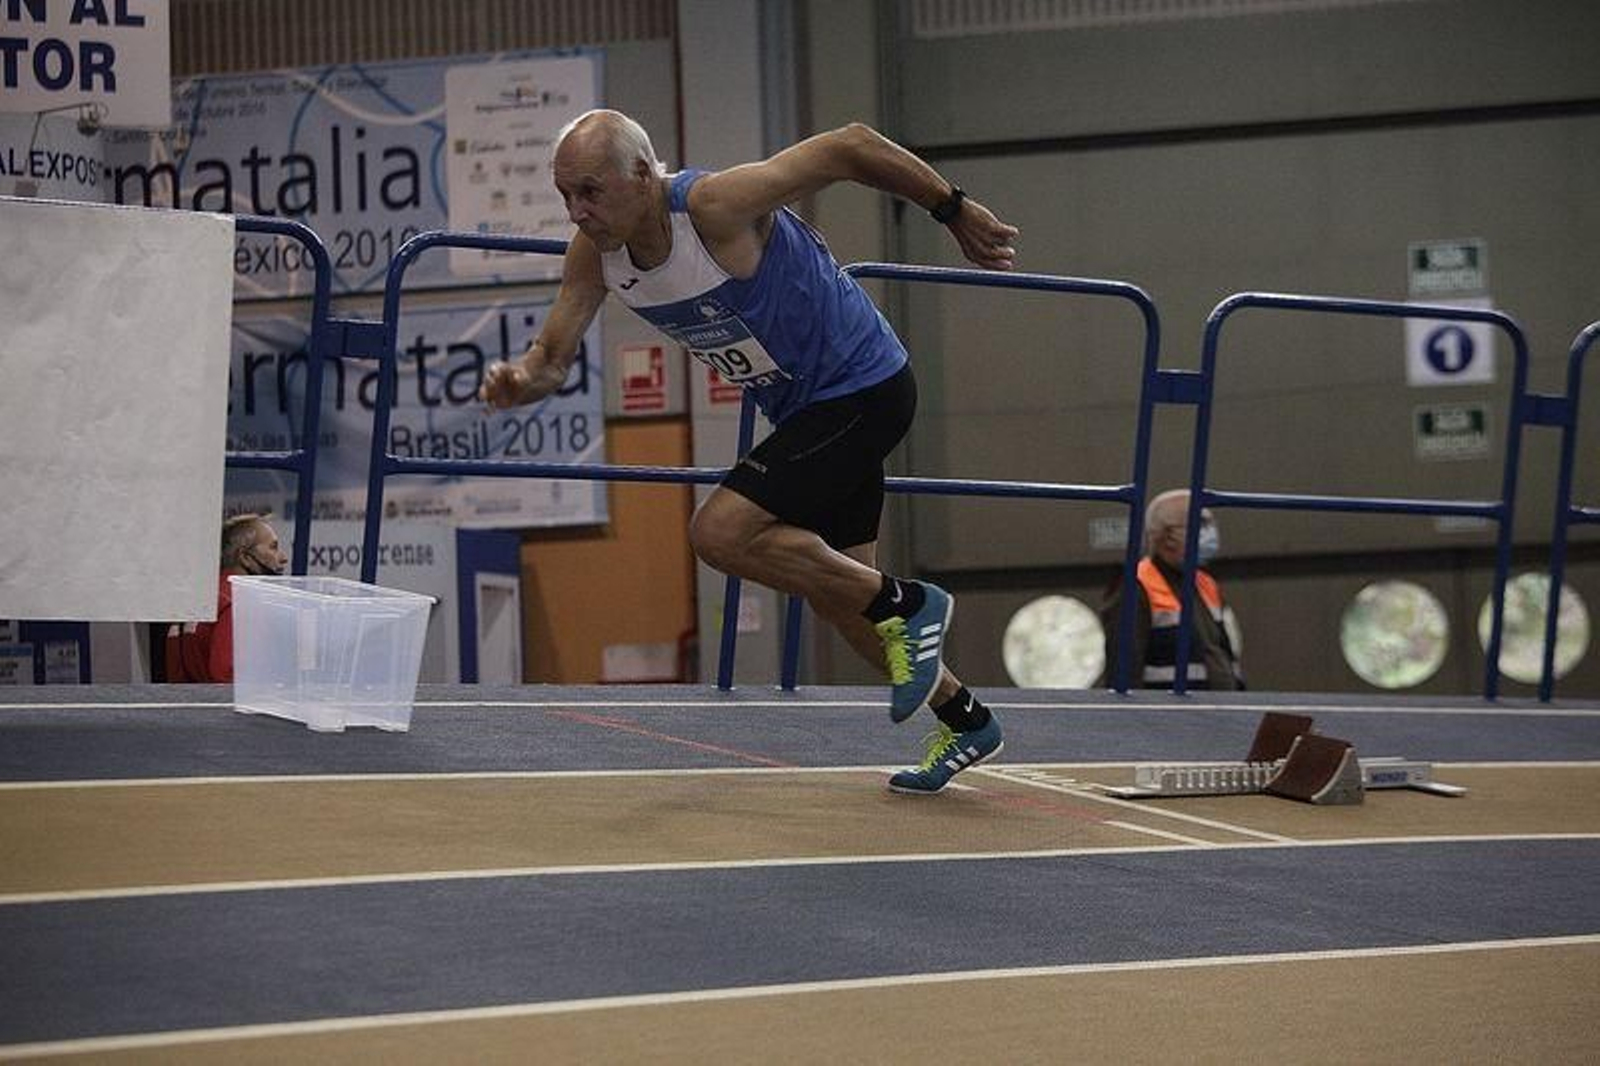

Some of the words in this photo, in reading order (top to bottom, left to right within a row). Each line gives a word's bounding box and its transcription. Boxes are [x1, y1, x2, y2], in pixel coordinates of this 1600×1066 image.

[0, 37, 116, 92] TOR
[104, 125, 421, 217] matalia
[234, 236, 316, 274] éxico
[390, 420, 489, 458] Brasil
[502, 413, 590, 457] 2018
[310, 543, 435, 572] xporense
